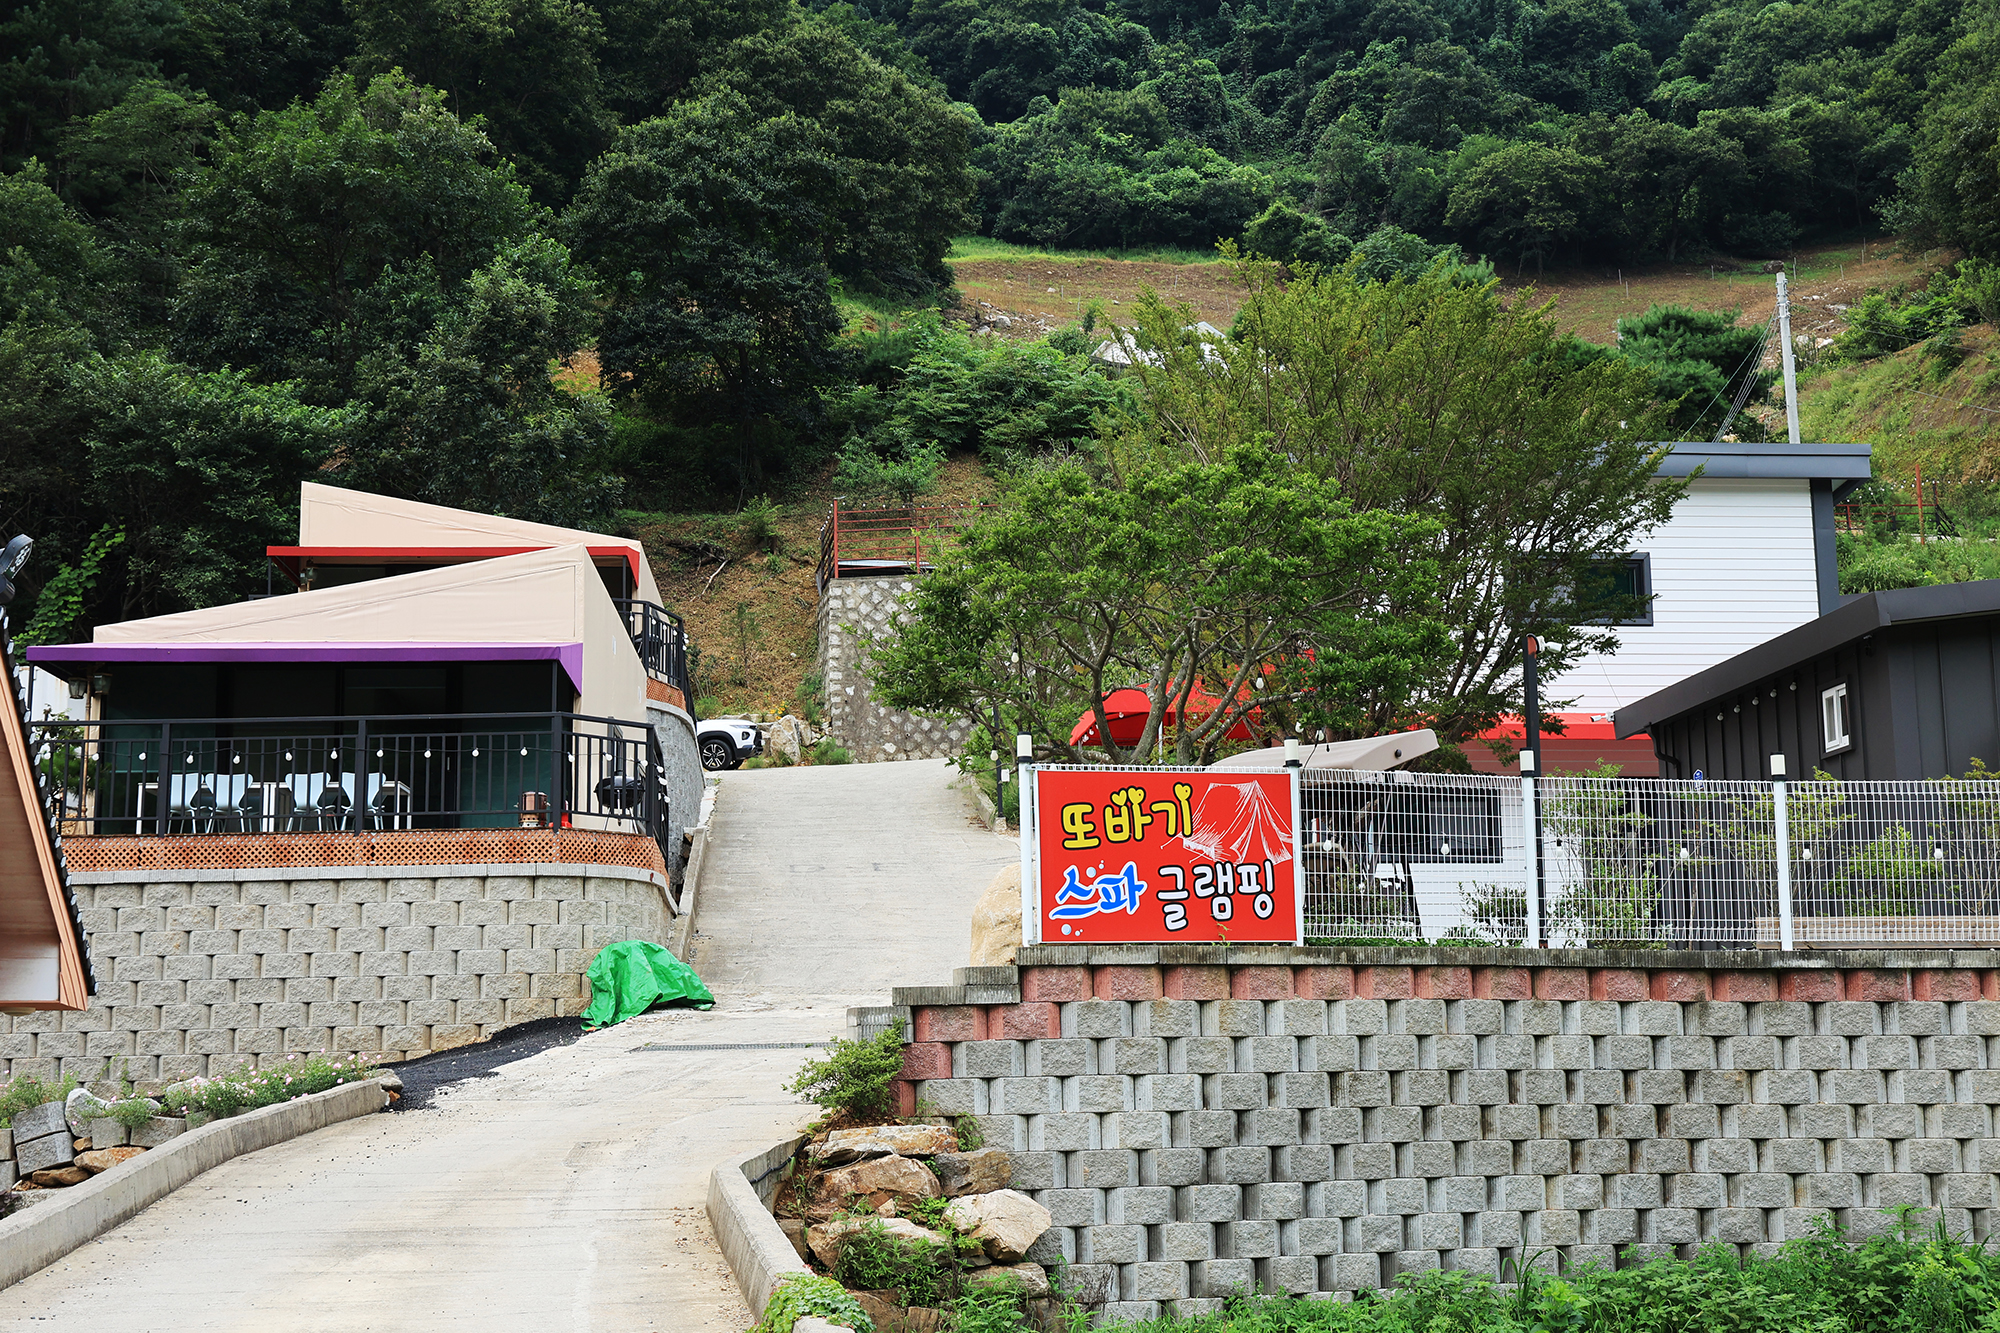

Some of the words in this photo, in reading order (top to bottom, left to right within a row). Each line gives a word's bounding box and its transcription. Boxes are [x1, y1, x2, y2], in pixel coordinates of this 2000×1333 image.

[1062, 782, 1193, 850] 또바기
[1050, 861, 1148, 920] 스파
[1156, 859, 1275, 931] 글램핑
